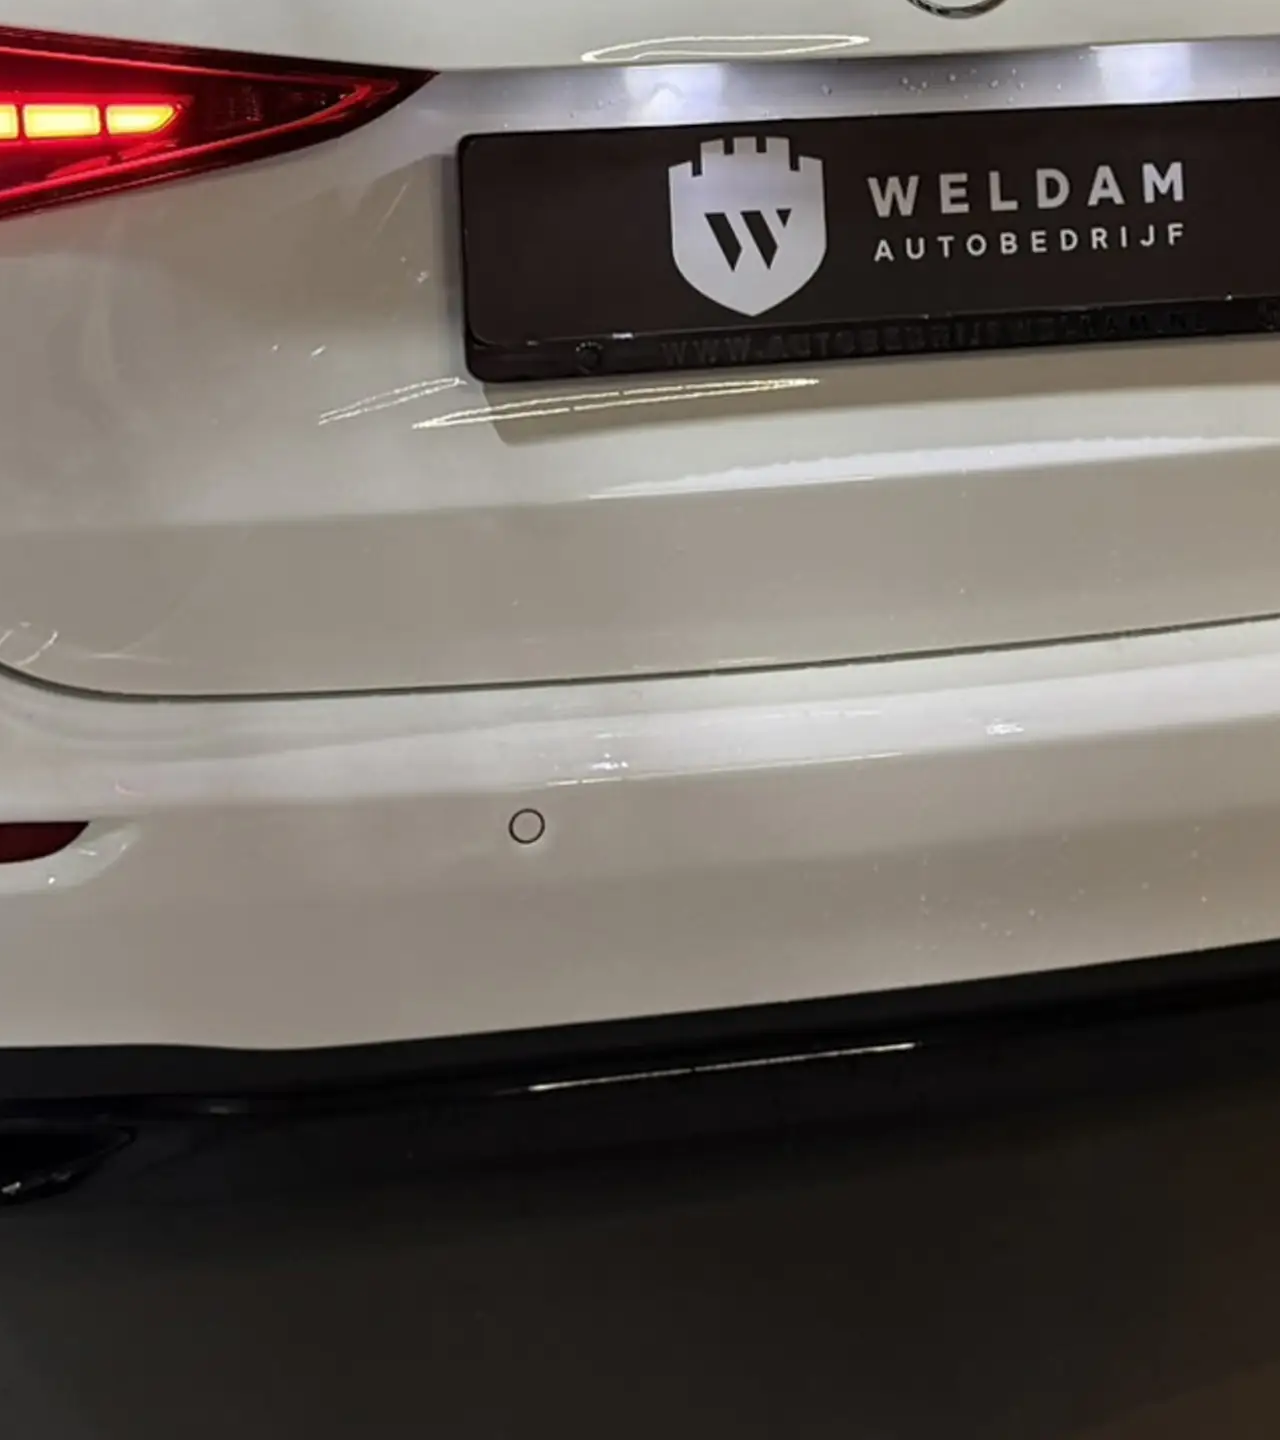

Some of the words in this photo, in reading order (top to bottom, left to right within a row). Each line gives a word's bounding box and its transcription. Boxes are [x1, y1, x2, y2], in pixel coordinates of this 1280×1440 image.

[867, 162, 1184, 217] WELDAM
[704, 208, 792, 272] W
[874, 223, 1184, 262] AUTOBEDRIJF
